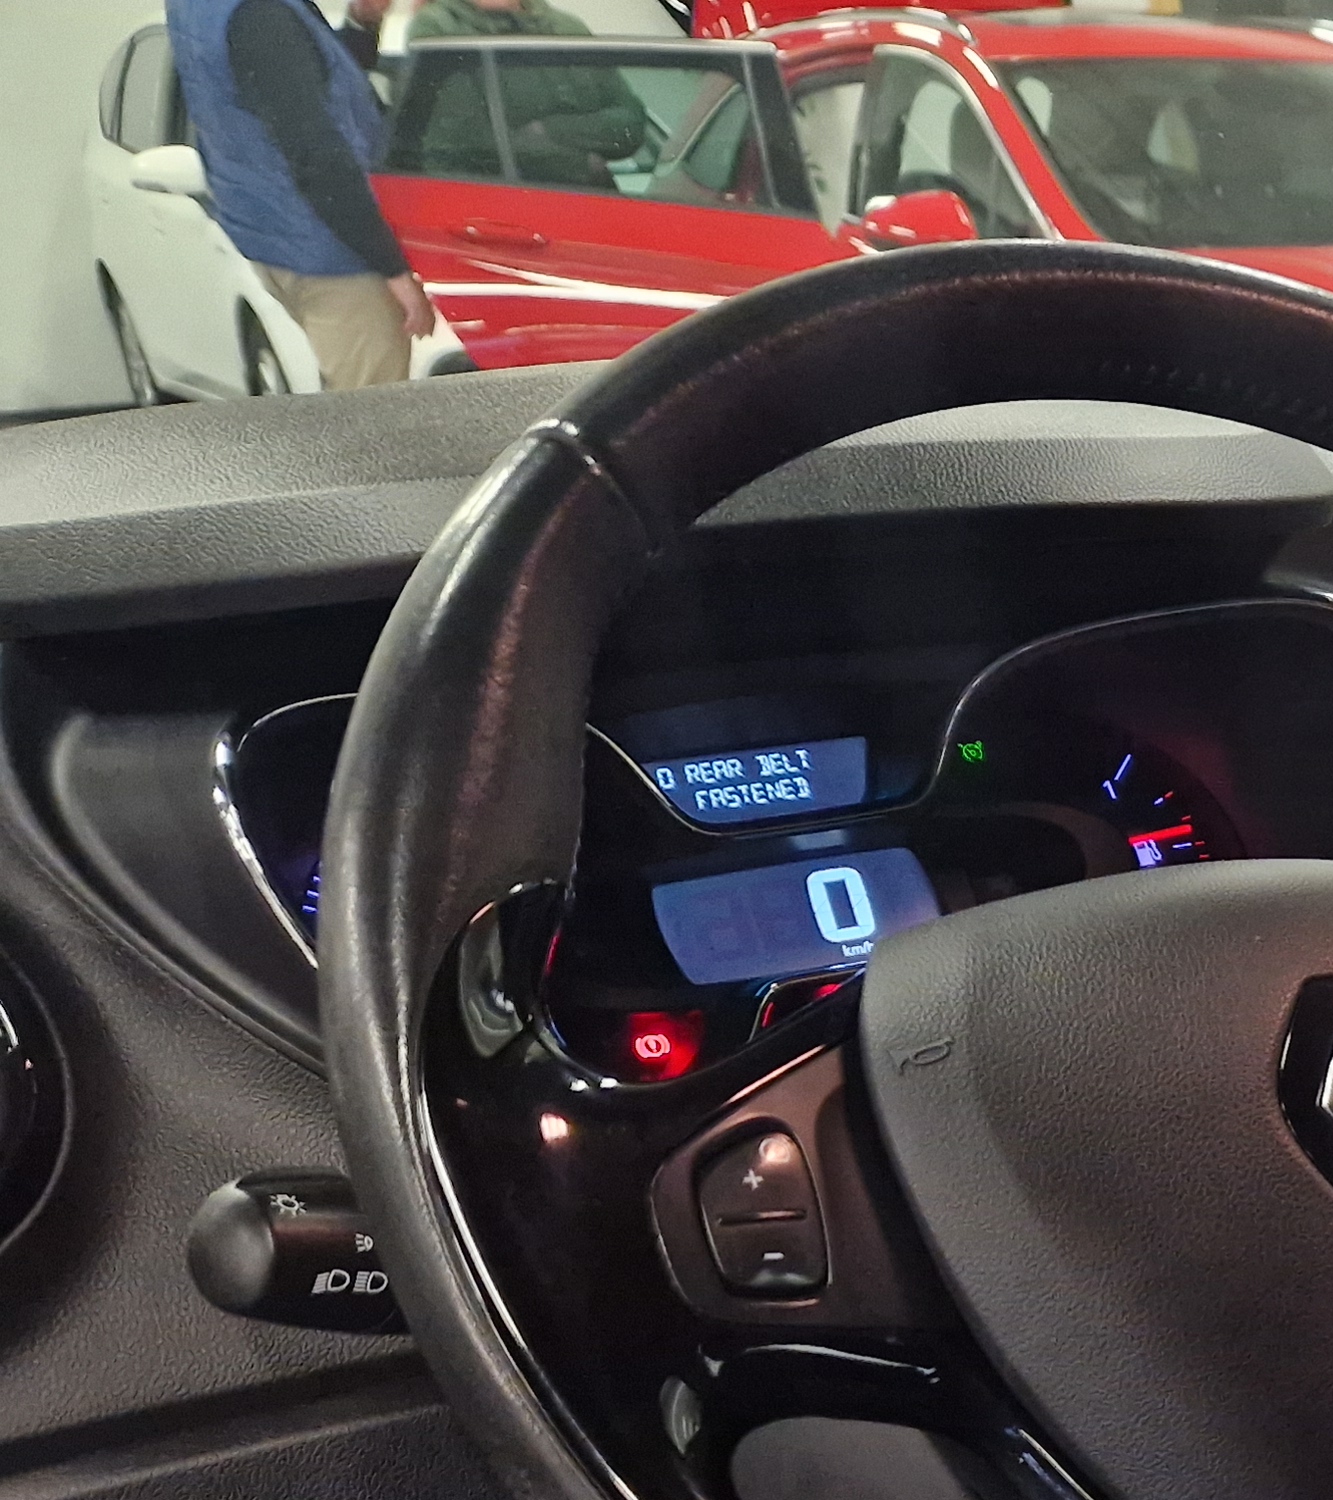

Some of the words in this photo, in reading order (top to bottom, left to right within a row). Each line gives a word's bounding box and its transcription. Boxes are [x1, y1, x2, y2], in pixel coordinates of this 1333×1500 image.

[684, 758, 745, 785] REAR
[755, 749, 814, 777] BELT
[695, 777, 813, 812] FASTENED
[806, 866, 876, 943] 0
